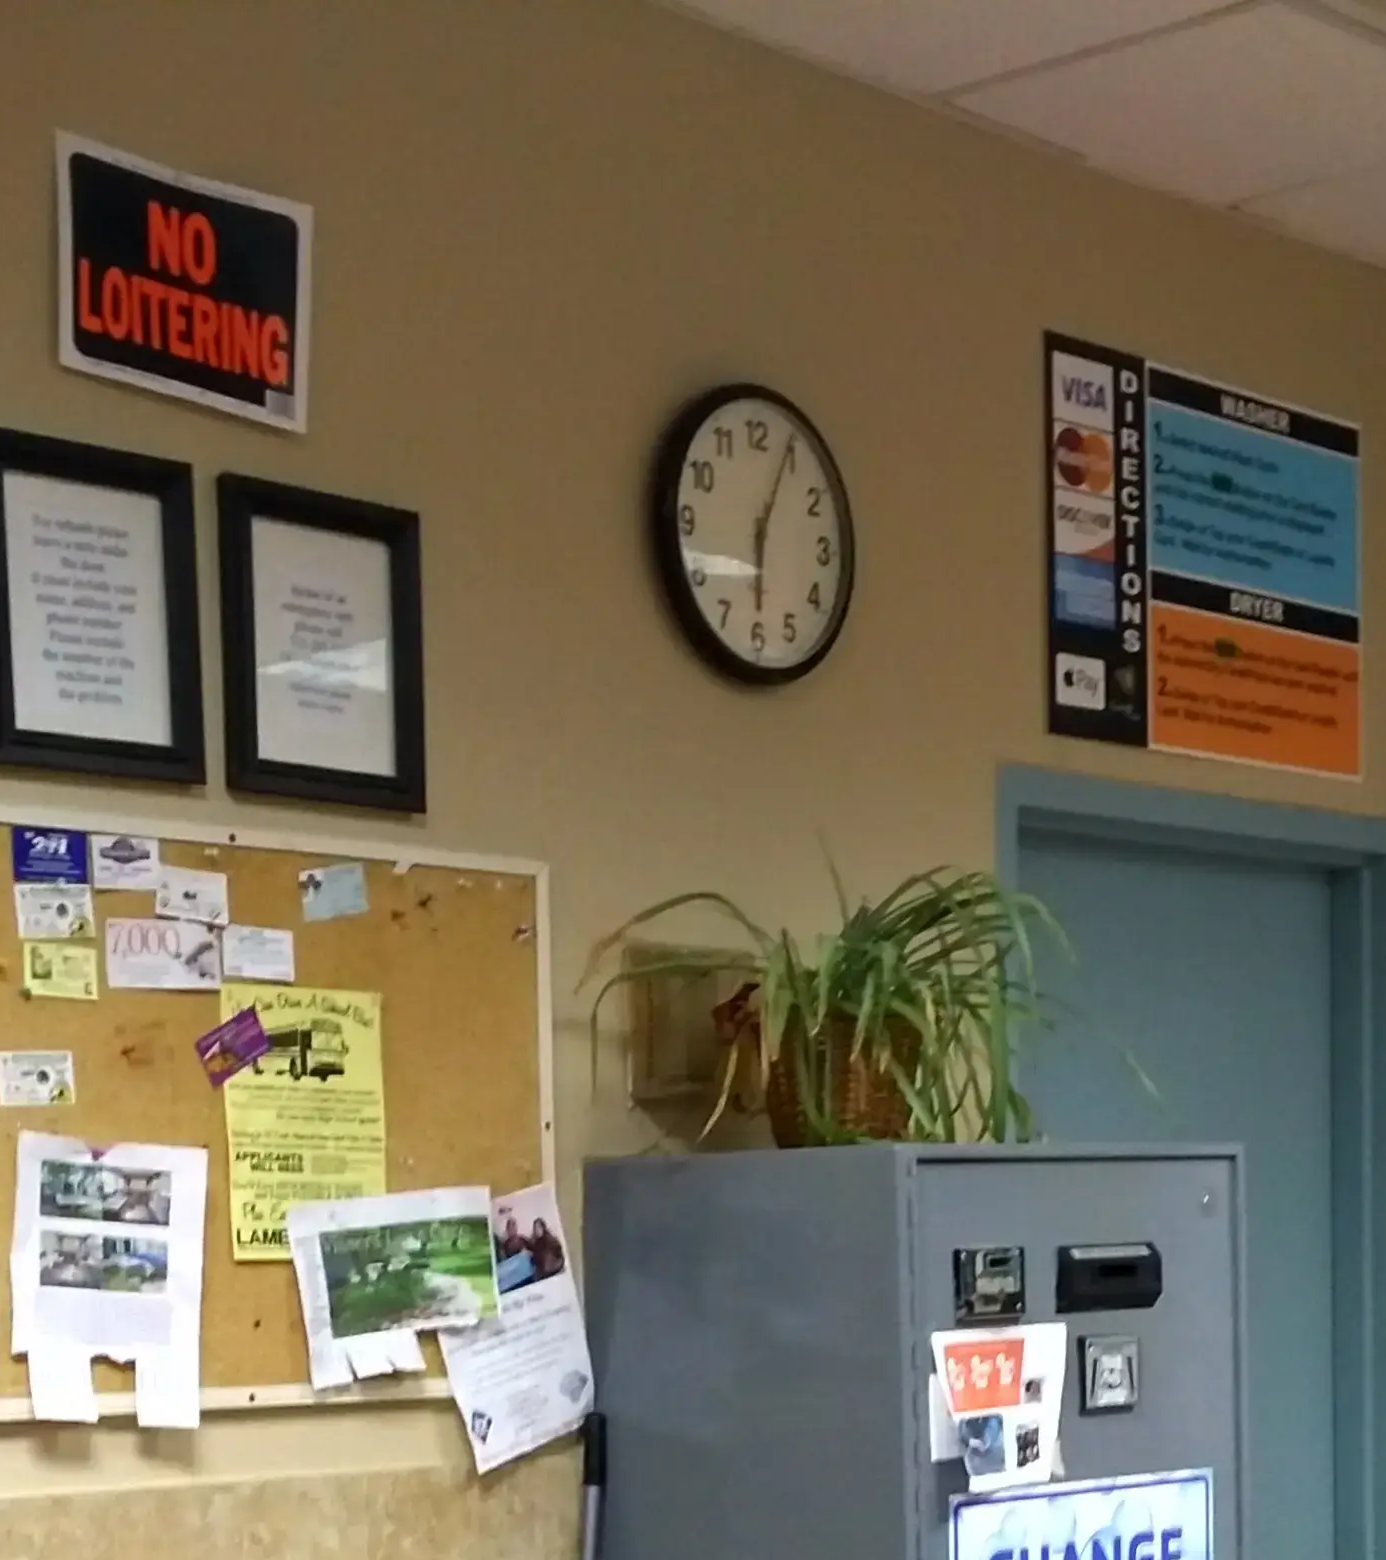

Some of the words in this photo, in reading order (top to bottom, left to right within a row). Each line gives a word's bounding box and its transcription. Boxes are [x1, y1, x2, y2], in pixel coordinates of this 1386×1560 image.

[146, 199, 218, 286] NO
[78, 256, 290, 388] LOITERING
[1062, 374, 1108, 412] VISA
[714, 426, 734, 460] 11
[744, 419, 769, 452] 12
[689, 459, 715, 494] 10
[806, 486, 821, 518] 2
[679, 504, 696, 536] 9
[816, 536, 831, 567] 3
[806, 581, 822, 613] 4
[717, 598, 732, 631] 7
[782, 612, 797, 644] 5
[750, 621, 766, 652] 6
